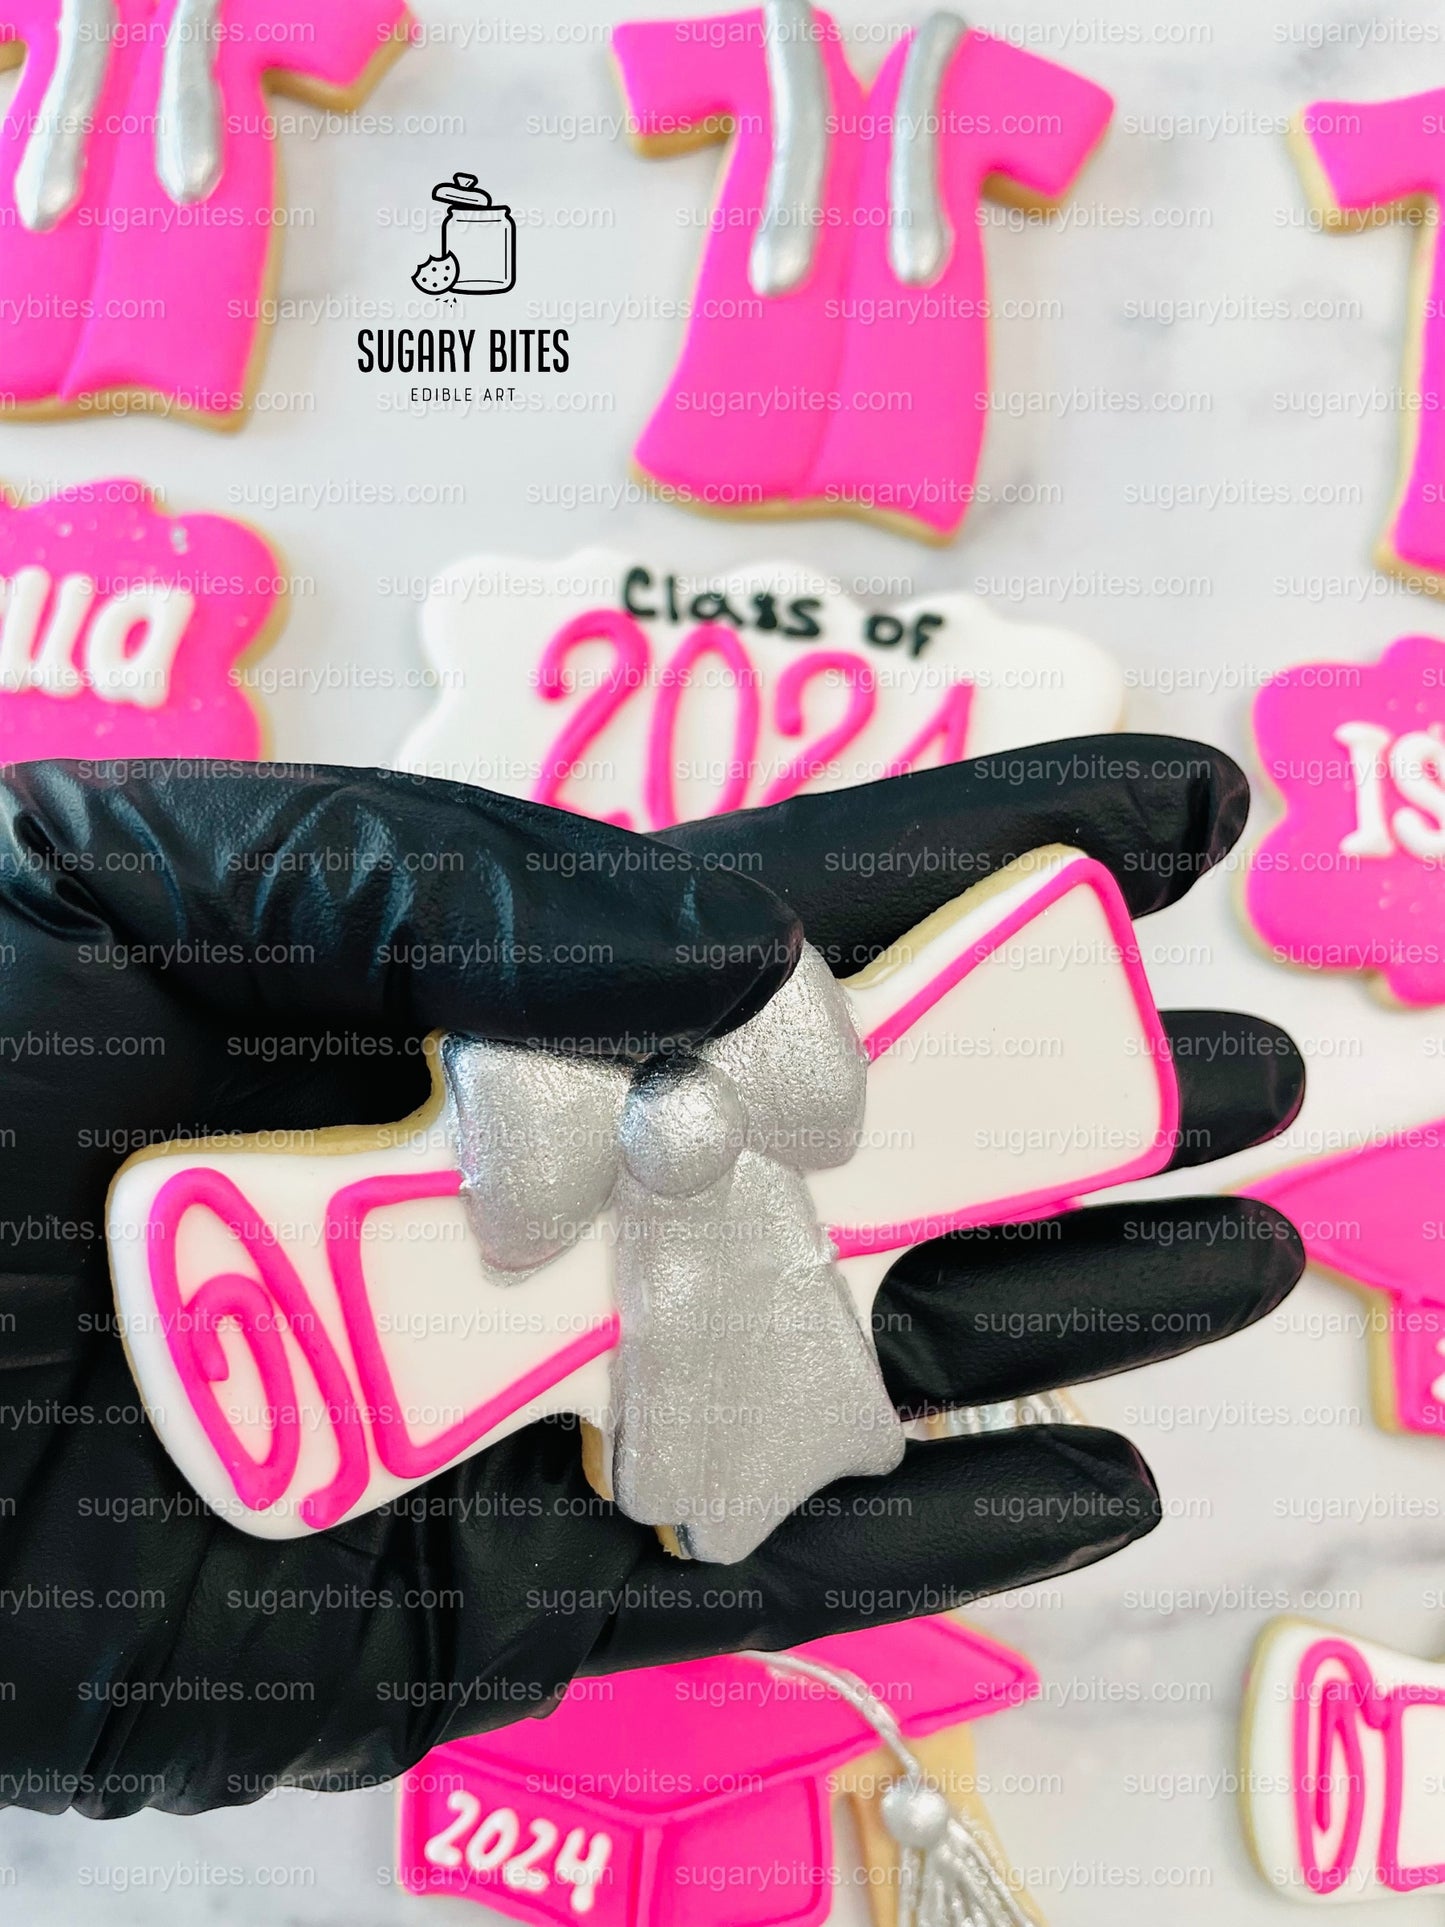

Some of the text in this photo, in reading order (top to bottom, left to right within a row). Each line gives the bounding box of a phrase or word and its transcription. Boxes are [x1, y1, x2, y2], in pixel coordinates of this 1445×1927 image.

[621, 565, 944, 659] Class of
[424, 1789, 613, 1912] 2024
